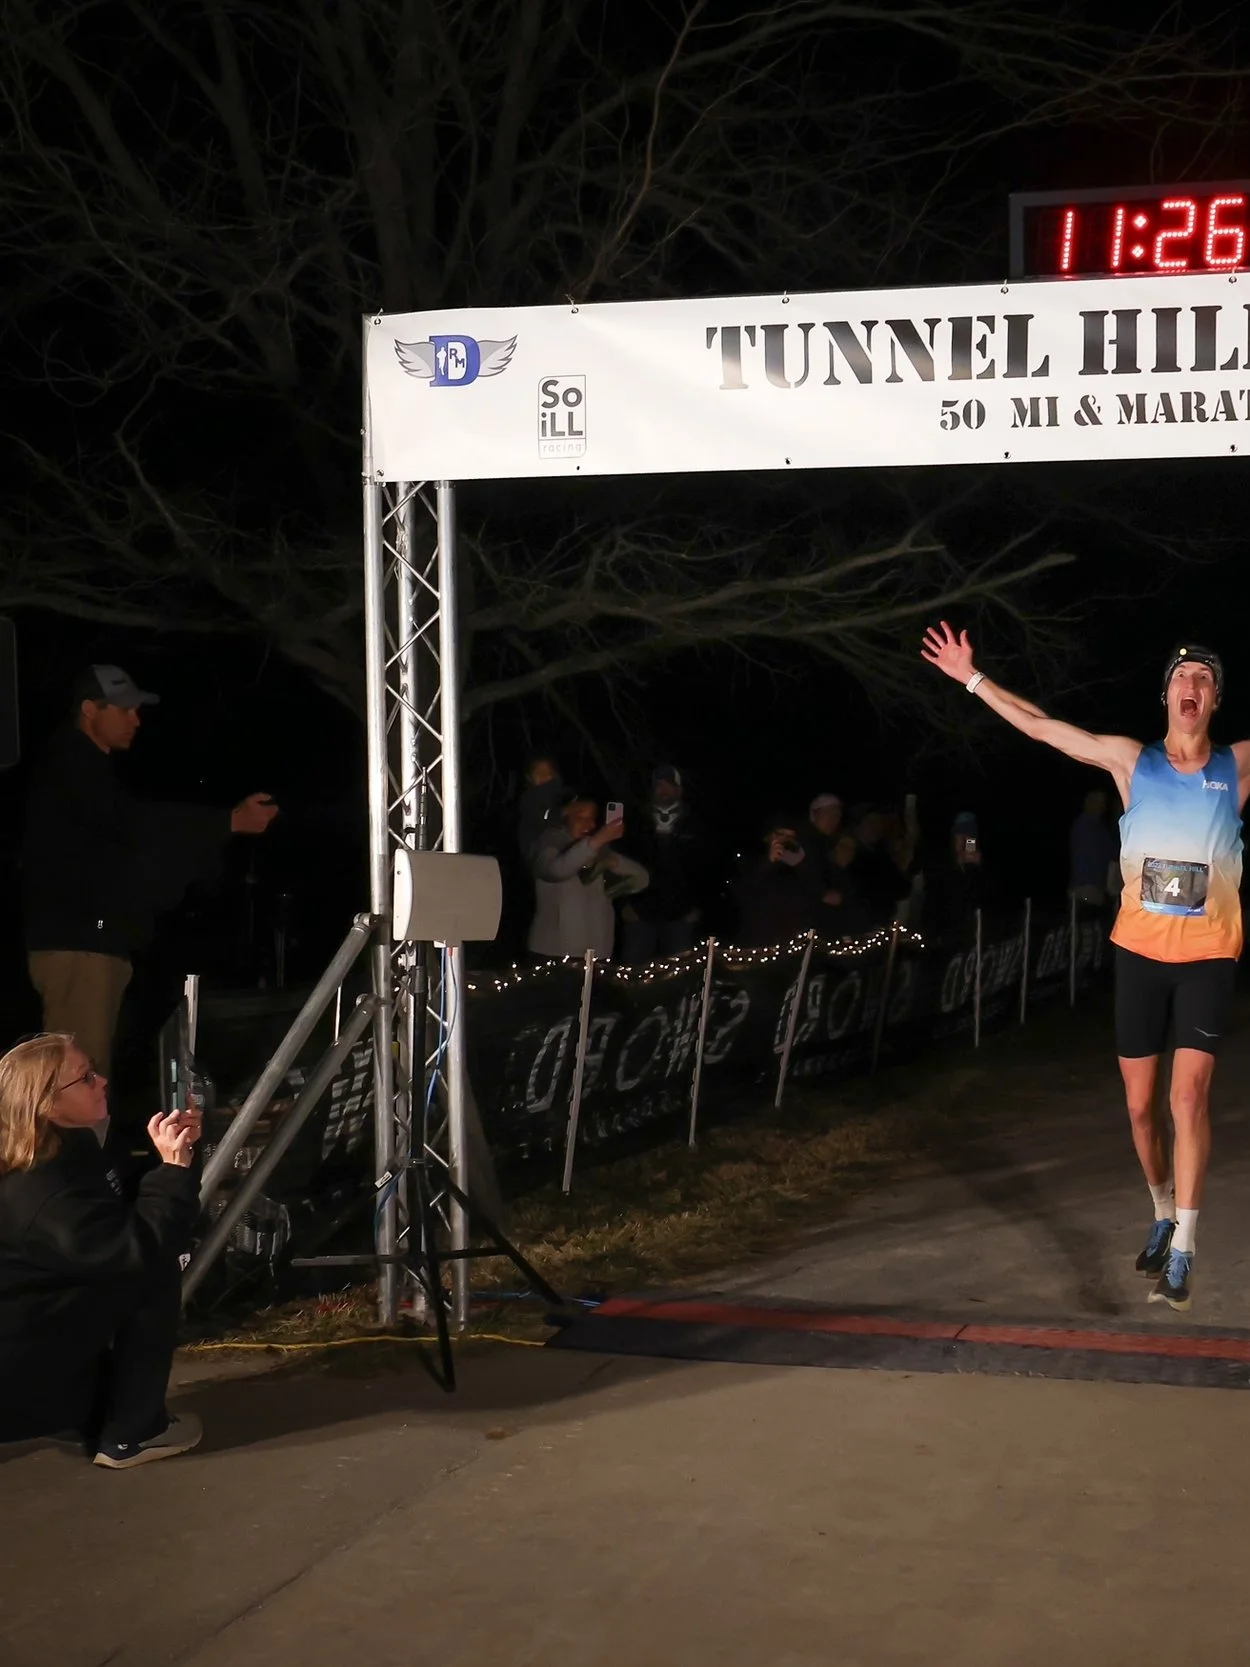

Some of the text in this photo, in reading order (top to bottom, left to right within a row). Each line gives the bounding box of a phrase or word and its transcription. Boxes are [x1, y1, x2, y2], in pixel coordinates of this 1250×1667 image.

[705, 314, 1050, 390] TUNNEL
[541, 379, 583, 409] So
[940, 399, 987, 431] 50
[1010, 396, 1060, 429] MI
[1074, 394, 1103, 426] &
[1202, 780, 1229, 791] HOKA
[1164, 877, 1181, 897] 4
